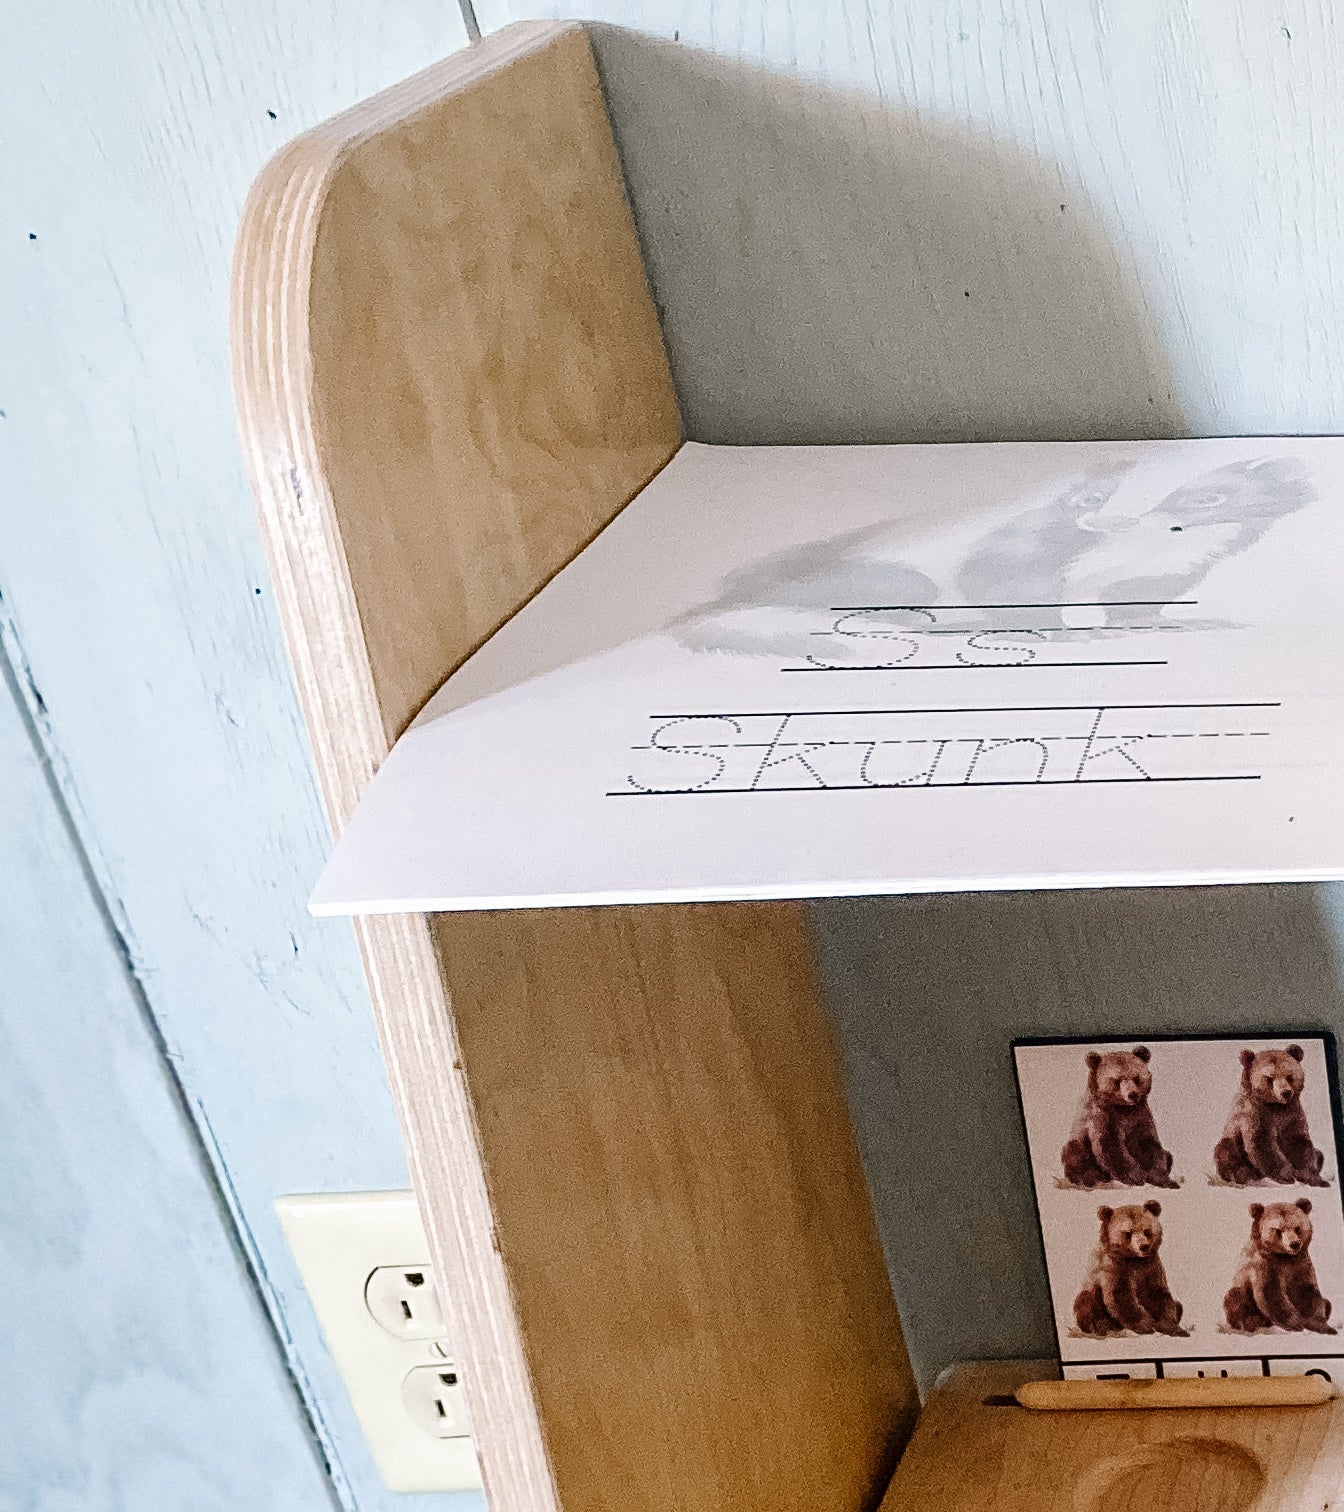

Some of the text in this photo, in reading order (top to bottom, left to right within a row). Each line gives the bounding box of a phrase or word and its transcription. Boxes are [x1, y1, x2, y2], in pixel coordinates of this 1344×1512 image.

[806, 607, 1047, 669] S s
[627, 707, 1152, 792] Skunk
